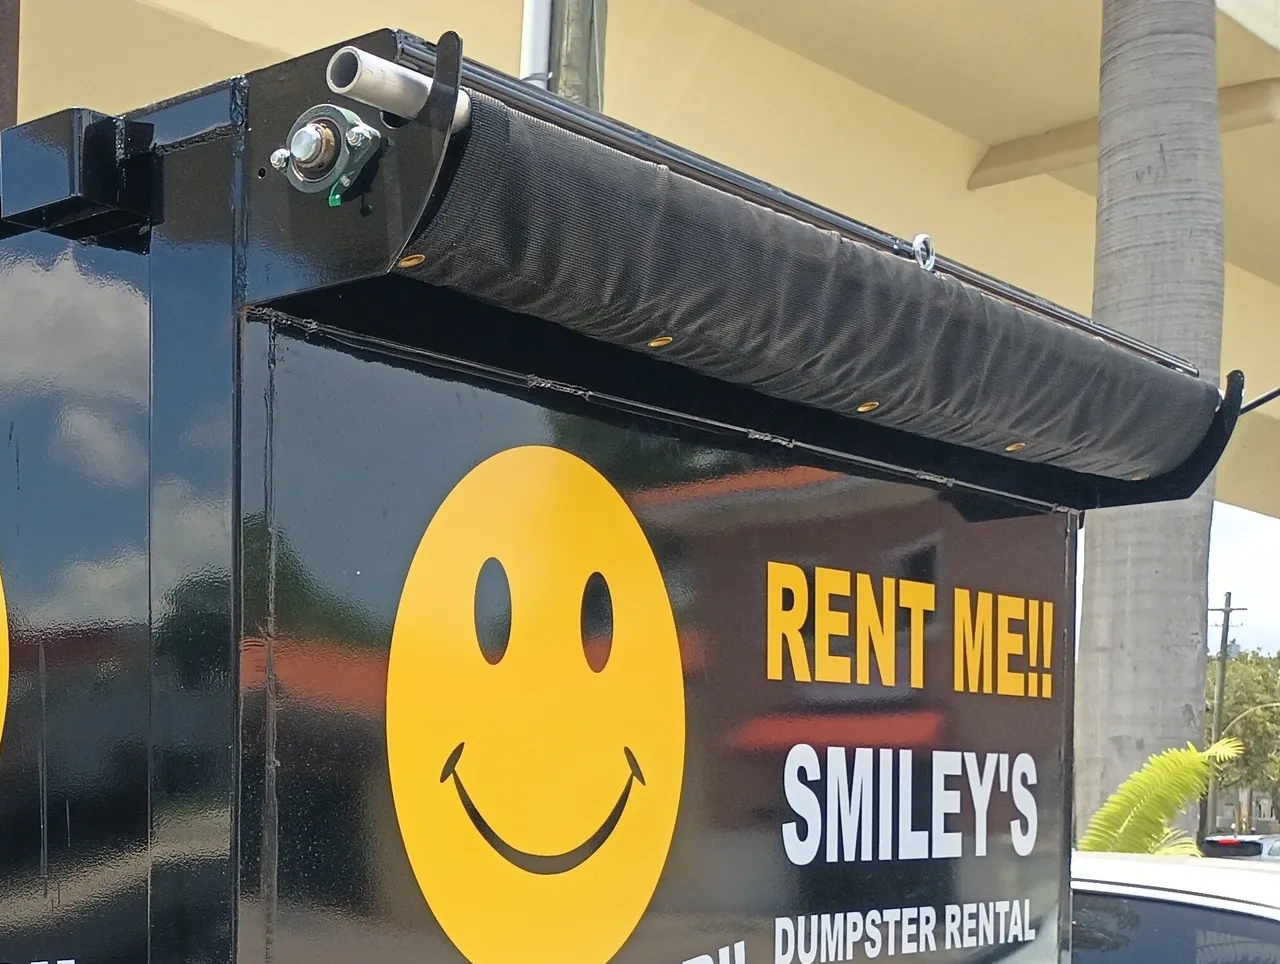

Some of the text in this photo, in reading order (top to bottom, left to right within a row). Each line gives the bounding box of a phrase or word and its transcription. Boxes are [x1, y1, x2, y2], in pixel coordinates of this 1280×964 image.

[766, 560, 1054, 699] RENT ME!!
[781, 743, 1038, 866] SMILEY'S
[944, 898, 1036, 950] RENTAL
